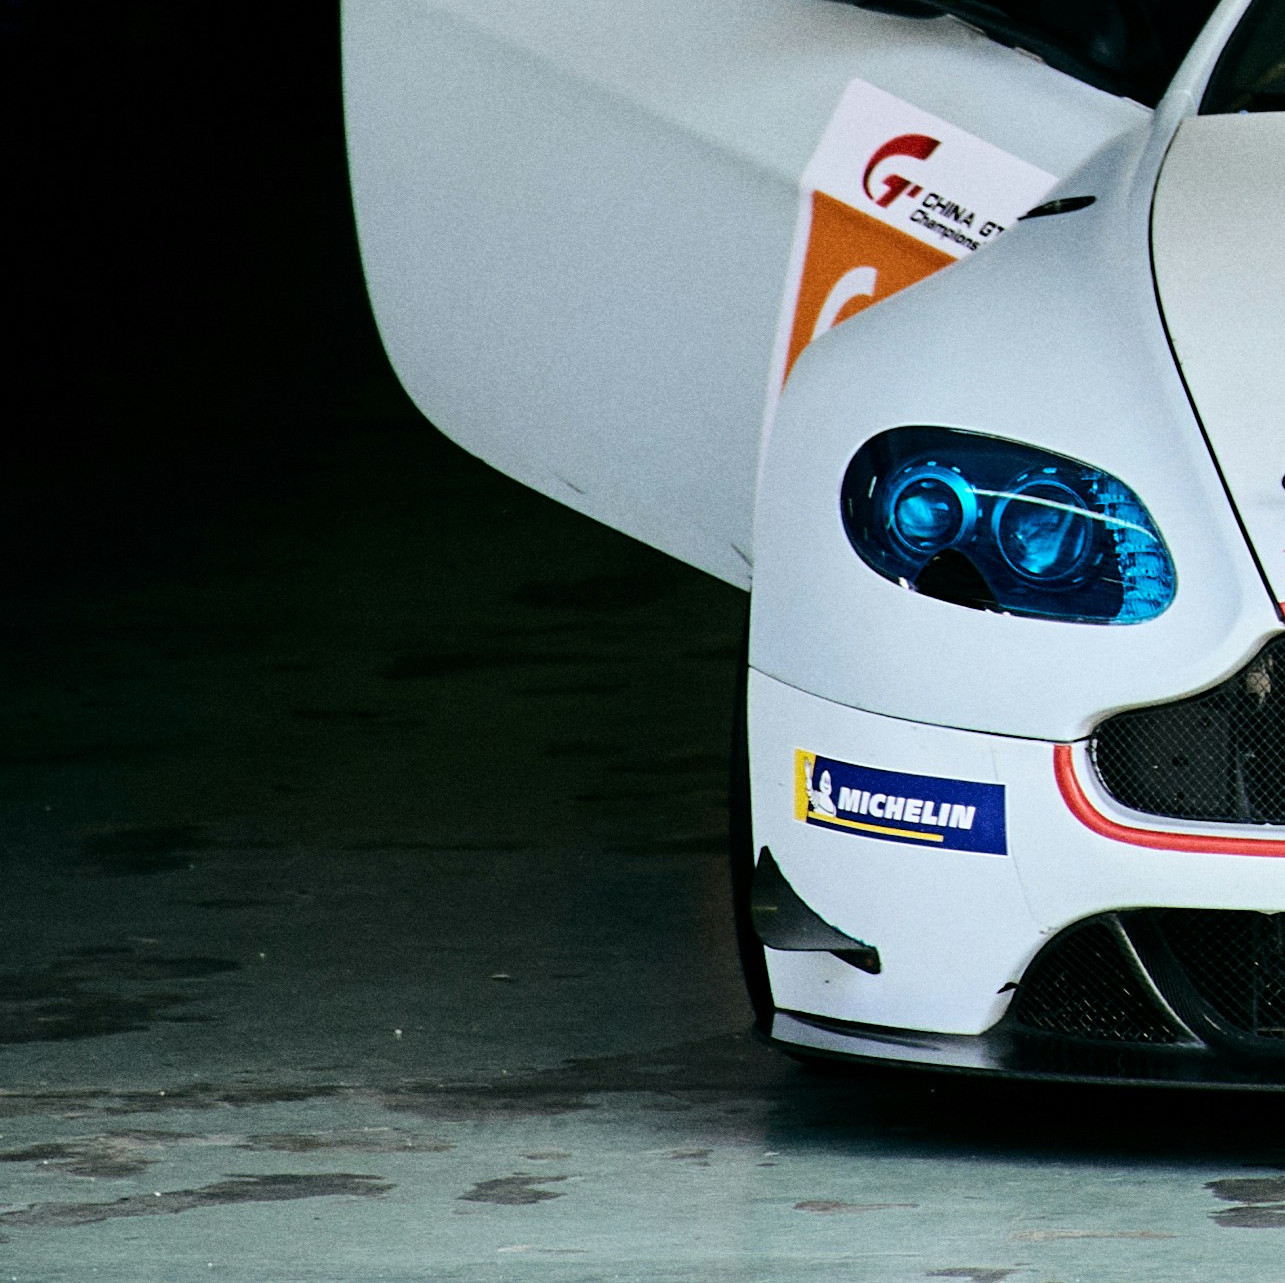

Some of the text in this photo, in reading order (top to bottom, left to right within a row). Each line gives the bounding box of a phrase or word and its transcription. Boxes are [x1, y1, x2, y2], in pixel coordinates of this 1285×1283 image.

[909, 209, 983, 252] Champions
[922, 192, 976, 229] CHINA
[837, 785, 976, 830] MICHELIN
